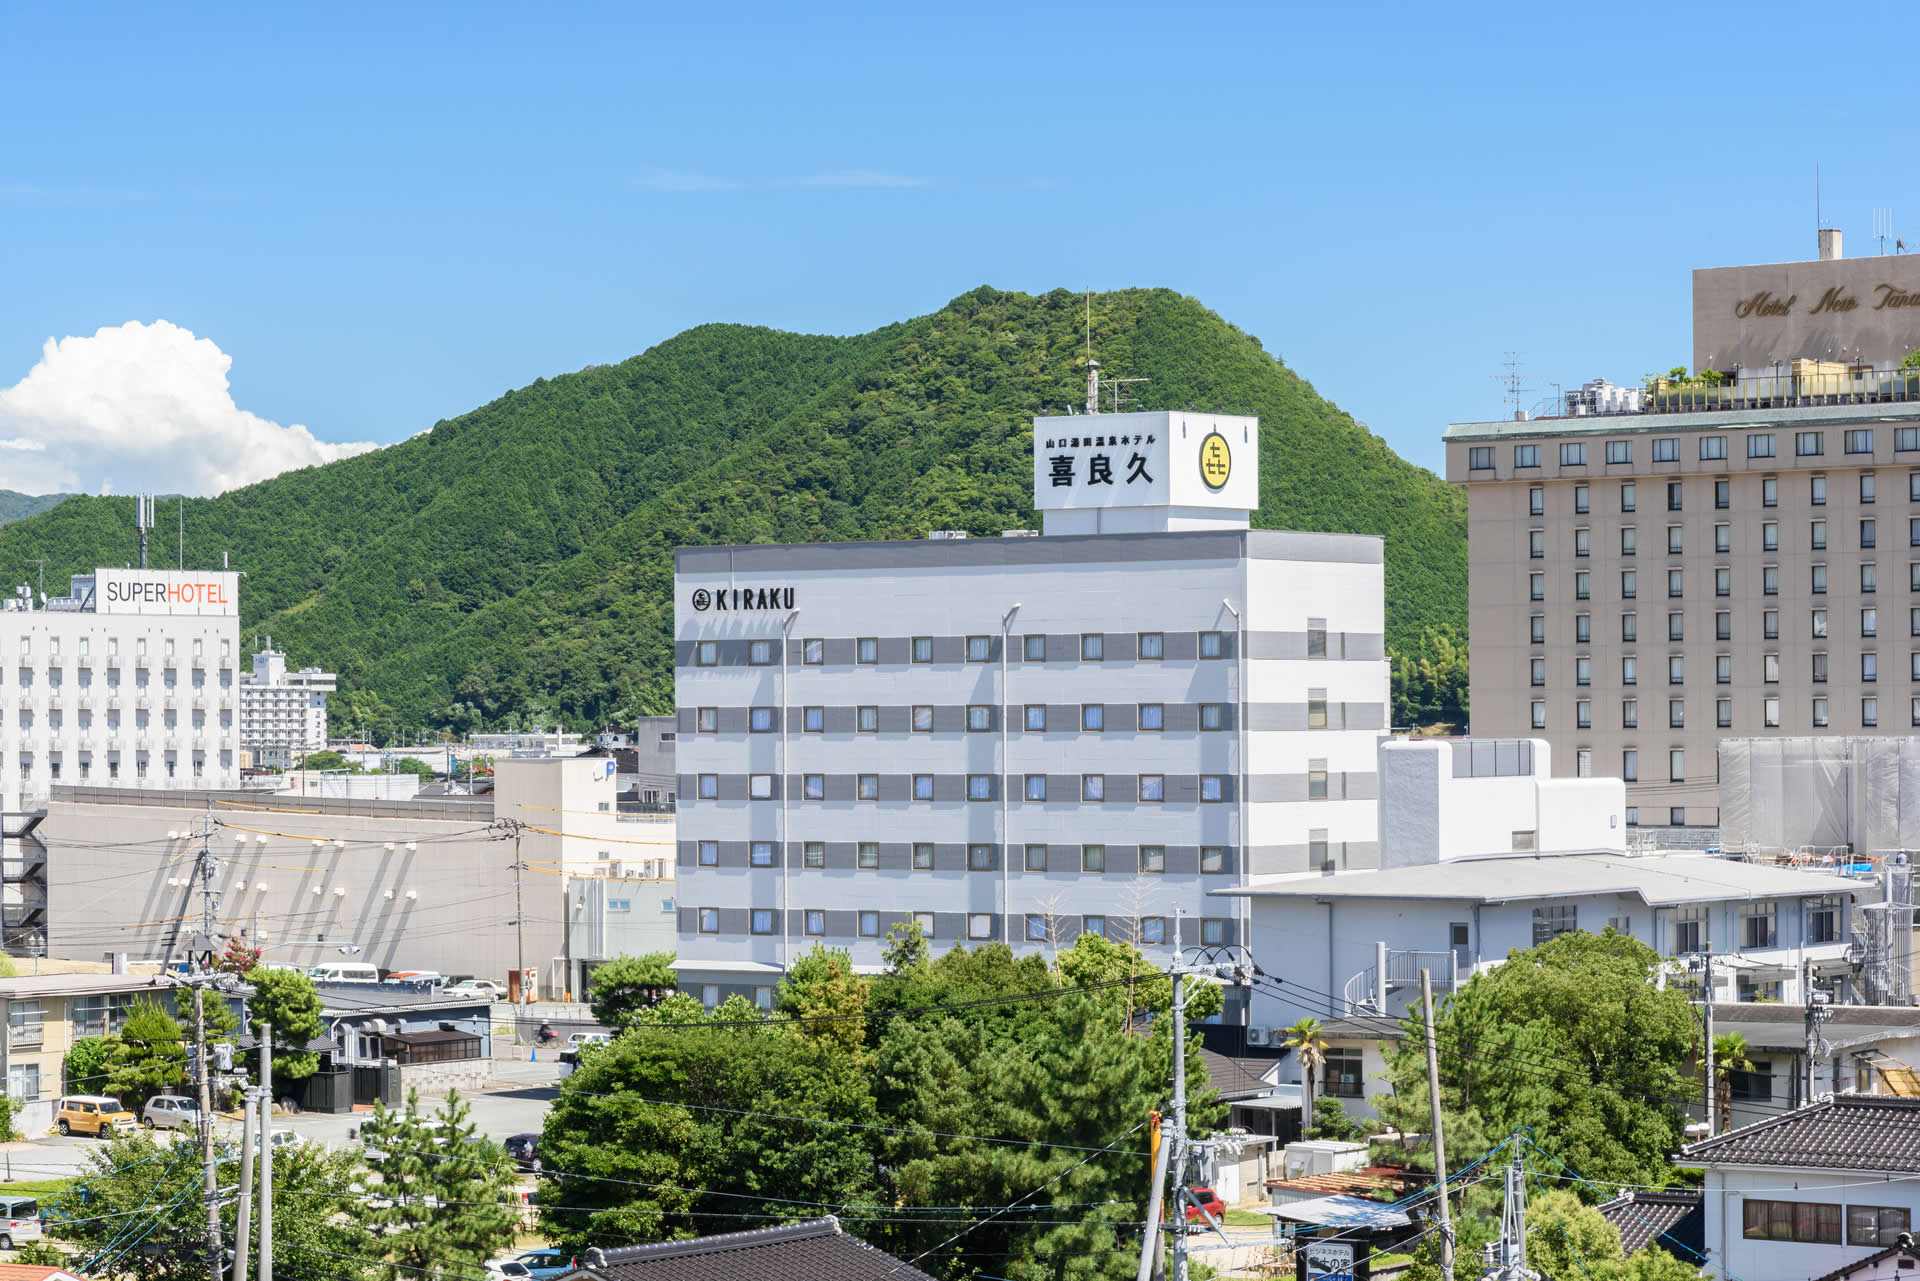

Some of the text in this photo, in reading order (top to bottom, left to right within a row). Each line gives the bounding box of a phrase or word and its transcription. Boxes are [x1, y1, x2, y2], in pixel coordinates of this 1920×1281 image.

[1735, 290, 1799, 319] Hotel
[1807, 285, 1860, 315] New
[1045, 434, 1156, 449] 山口湯田温泉ホテル
[1048, 452, 1155, 488] 喜良久
[716, 587, 795, 611] KIRAKU
